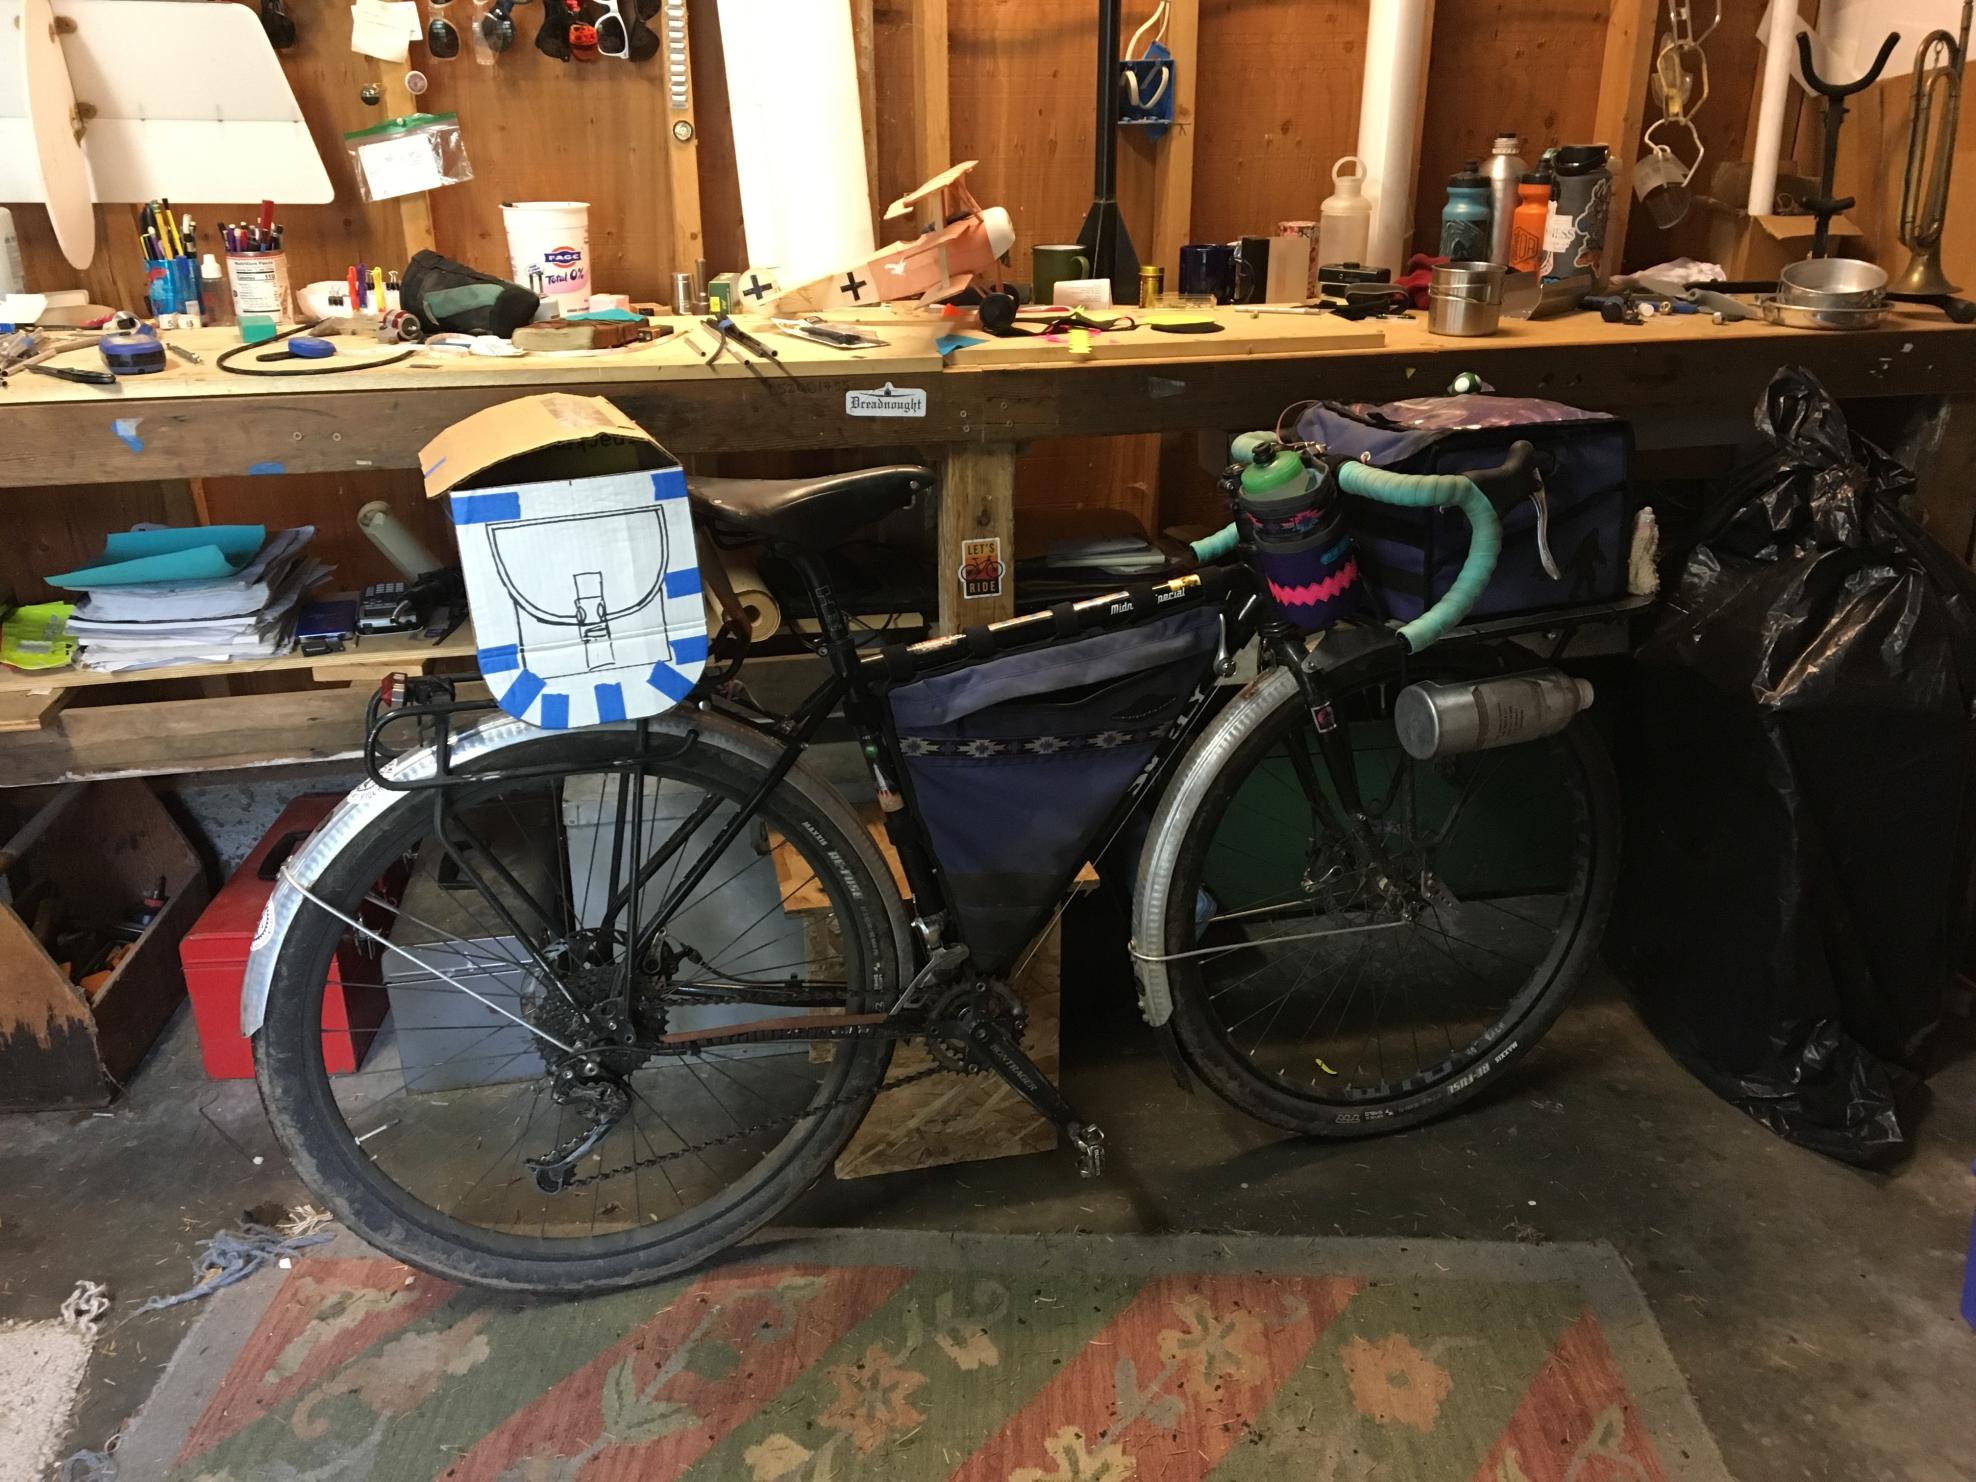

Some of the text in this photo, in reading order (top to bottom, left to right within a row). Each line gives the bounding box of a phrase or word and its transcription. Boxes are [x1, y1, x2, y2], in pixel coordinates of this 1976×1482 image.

[545, 267, 584, 285] Total 0%
[850, 396, 922, 413] Dreadnought
[967, 543, 995, 555] LET'S
[969, 580, 997, 593] RIDE
[1155, 586, 1186, 604] pecial
[802, 820, 829, 848] MAXXIS
[827, 850, 865, 900] RE-FUSE
[1494, 1040, 1519, 1064] MAXXIS
[989, 1044, 1038, 1092] BONTRAGER
